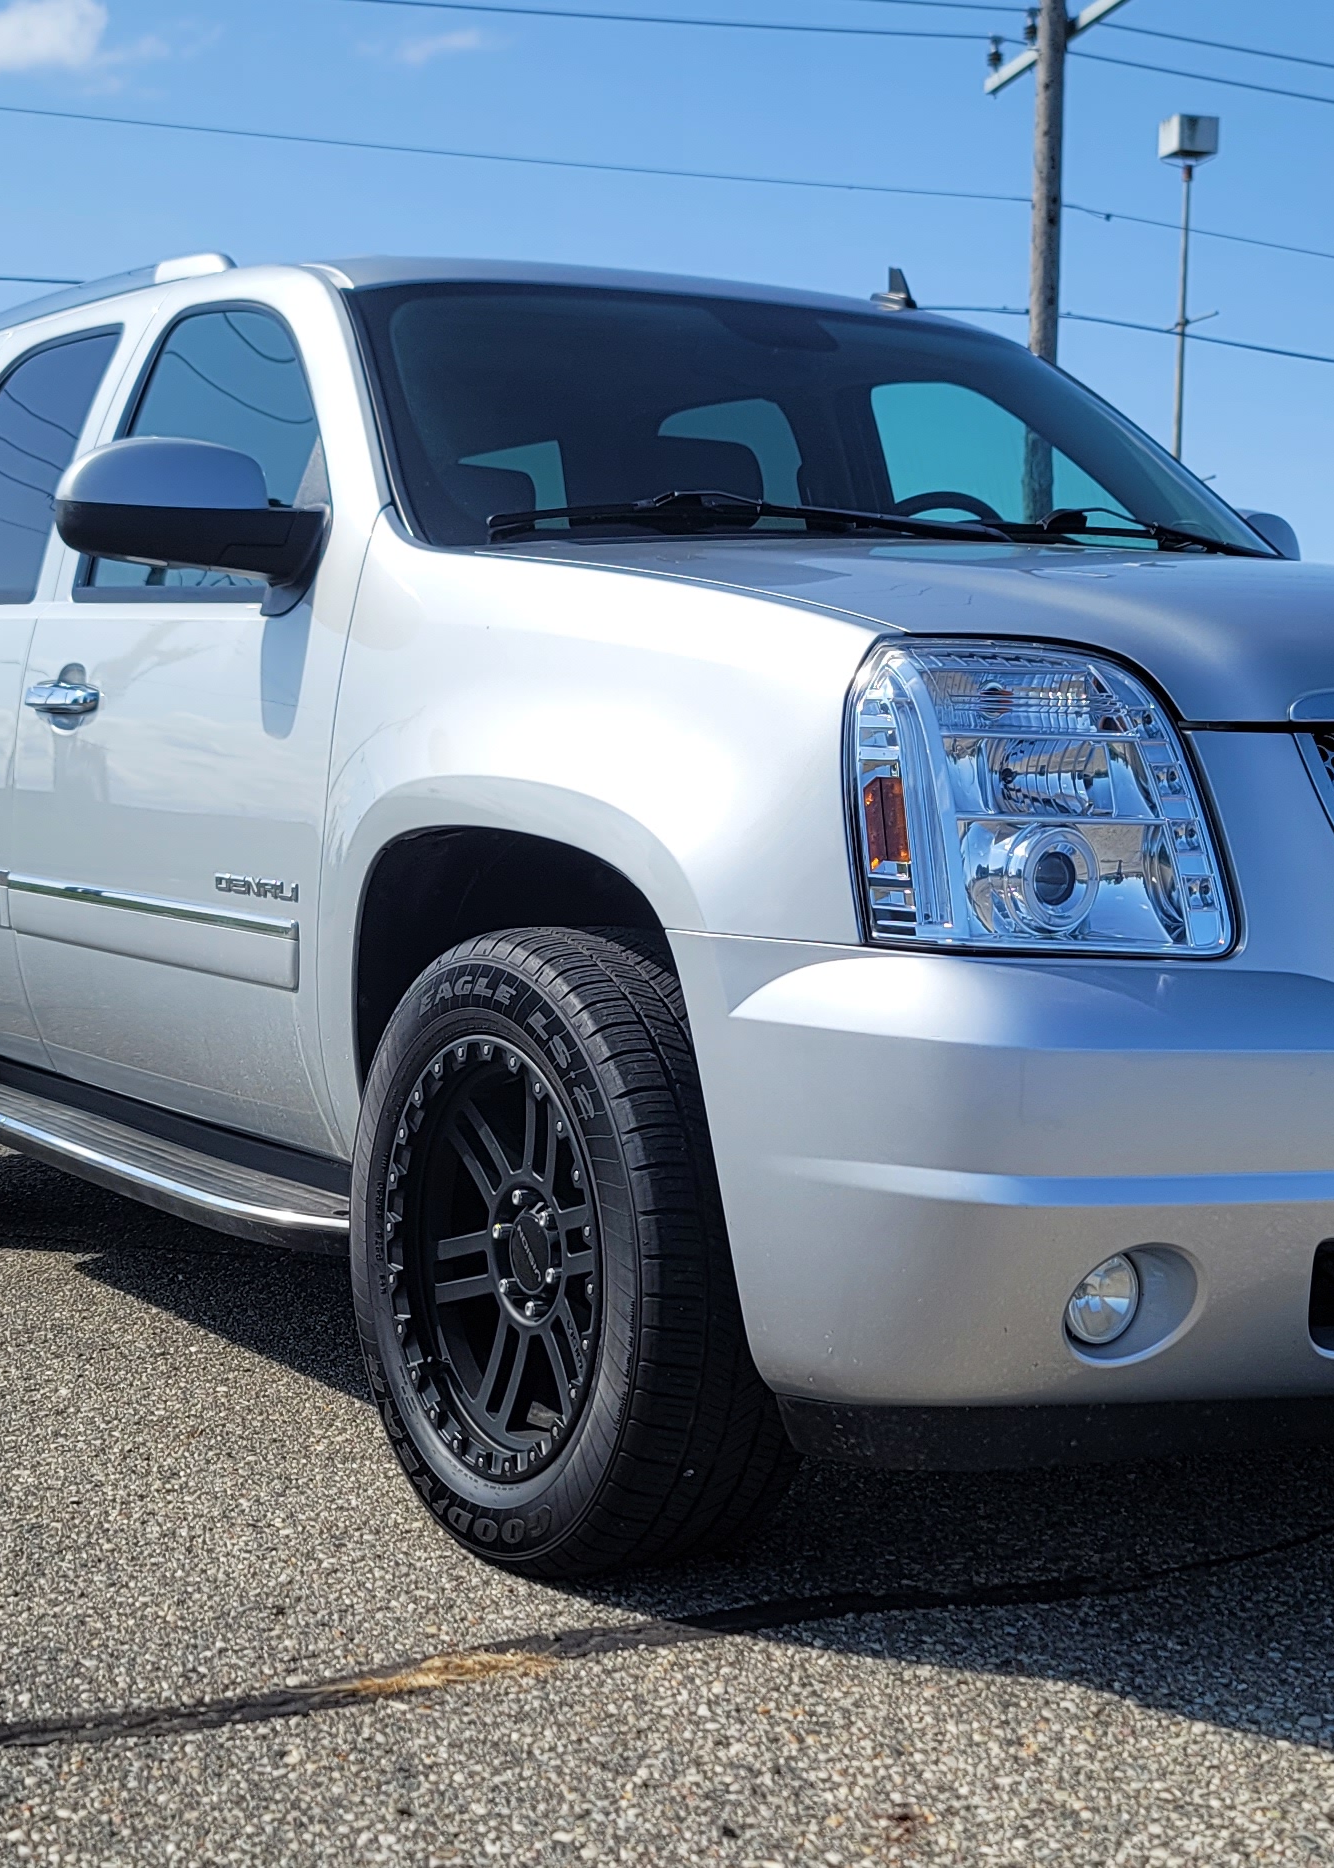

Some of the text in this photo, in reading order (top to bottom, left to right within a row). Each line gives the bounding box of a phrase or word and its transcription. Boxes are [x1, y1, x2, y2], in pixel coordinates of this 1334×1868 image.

[214, 872, 300, 903] DENALI
[418, 975, 517, 1017] EAGLE
[515, 1224, 543, 1283] VISION
